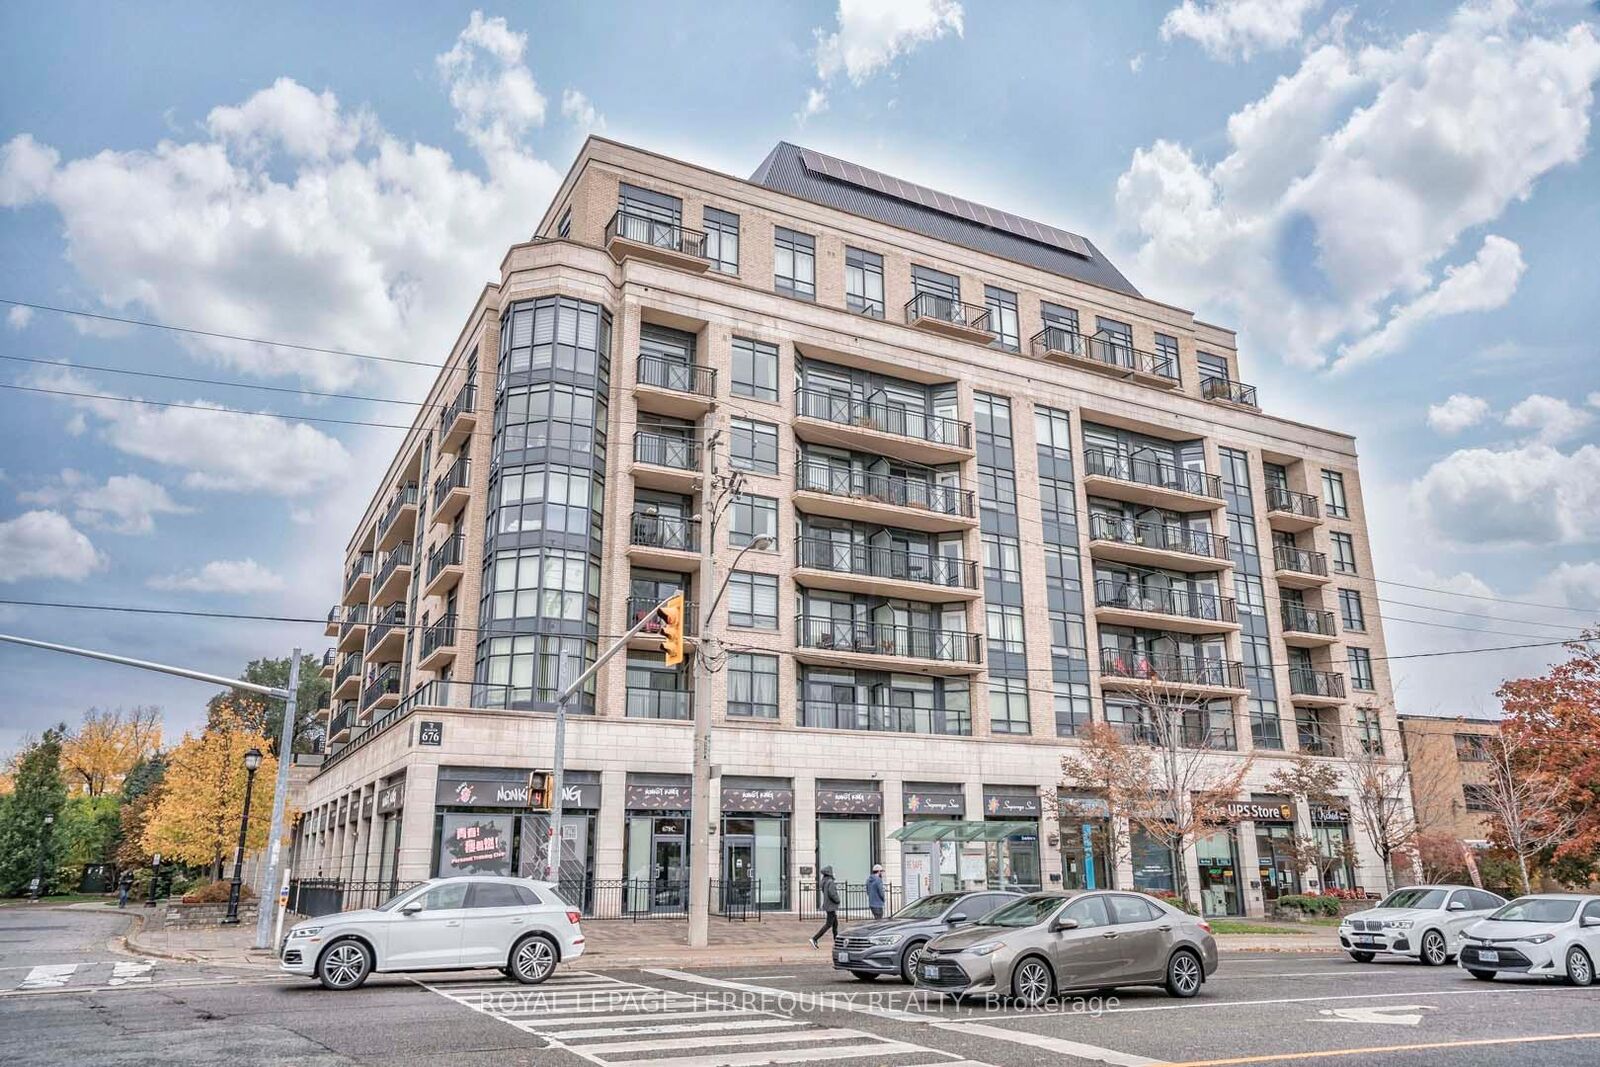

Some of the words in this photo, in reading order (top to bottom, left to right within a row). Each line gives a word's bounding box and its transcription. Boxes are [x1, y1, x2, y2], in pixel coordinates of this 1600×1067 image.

[422, 731, 440, 741] 676
[1227, 804, 1250, 818] UPS
[1251, 805, 1280, 818] Store
